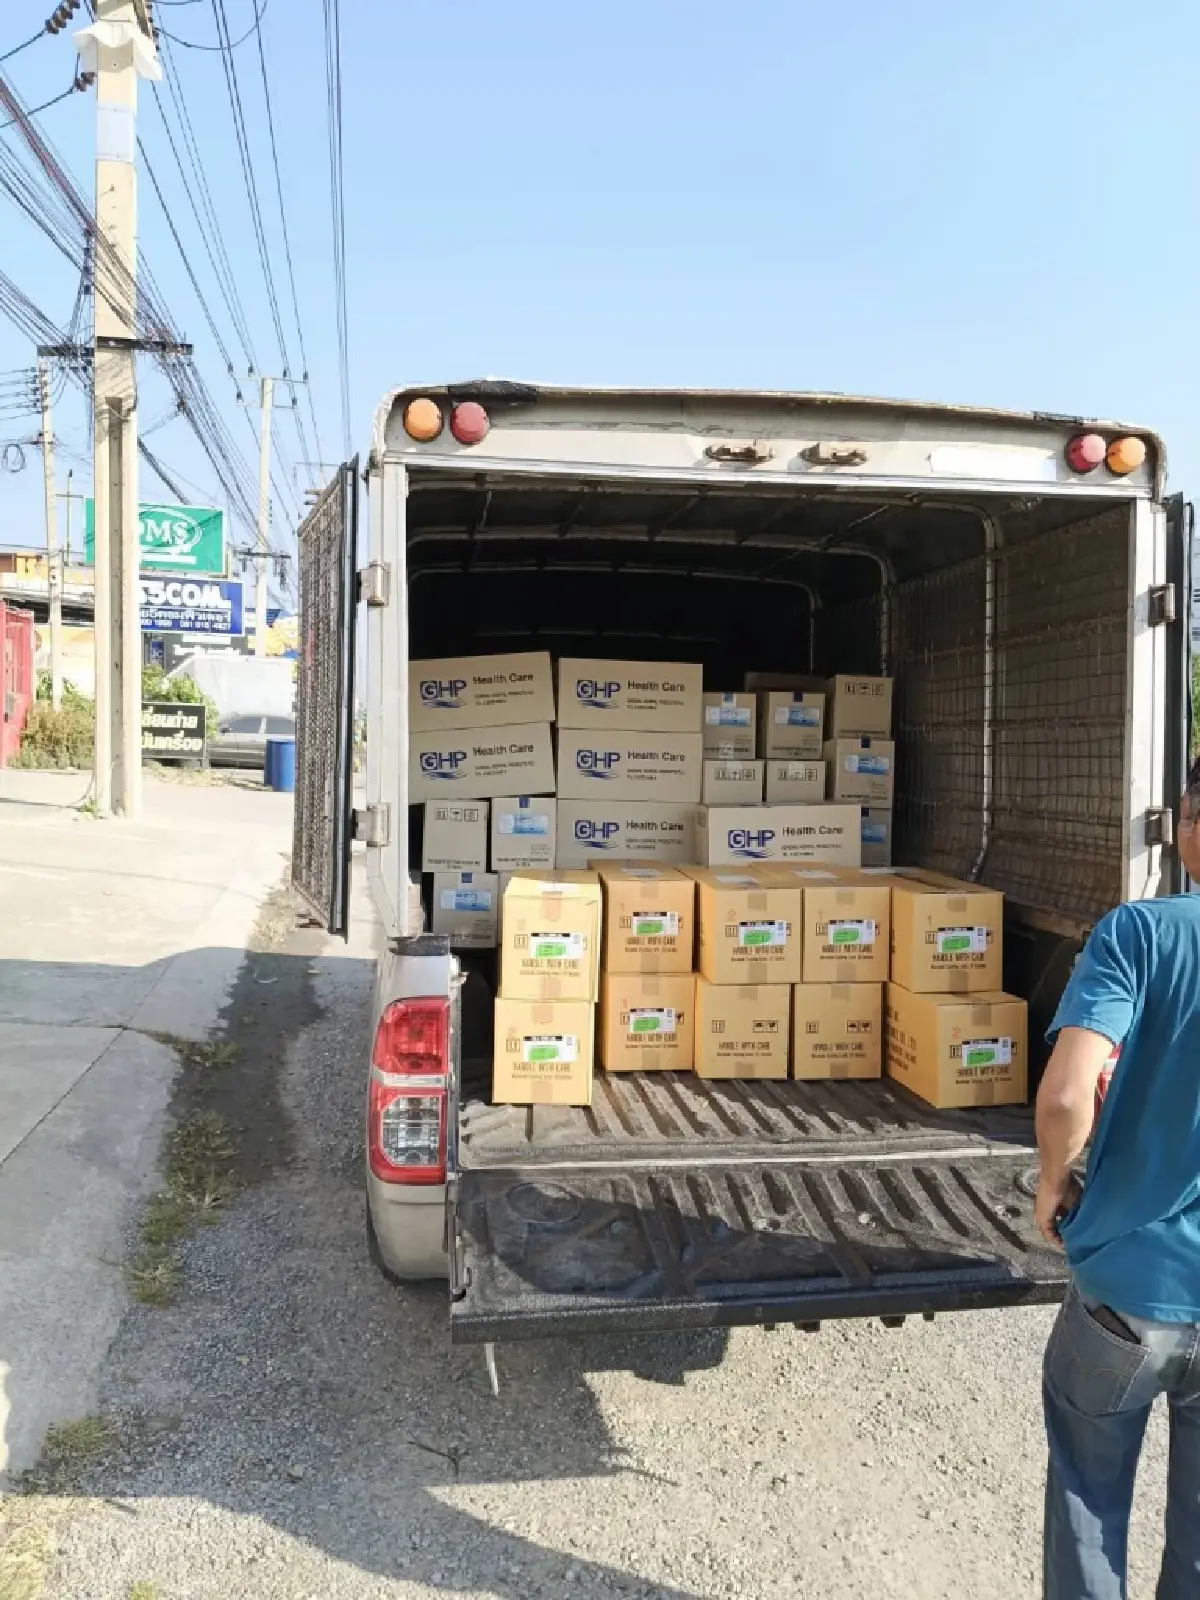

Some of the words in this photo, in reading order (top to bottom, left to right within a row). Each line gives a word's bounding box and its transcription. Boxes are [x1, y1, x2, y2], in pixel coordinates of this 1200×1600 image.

[472, 674, 507, 685] Health
[509, 672, 534, 682] Care
[627, 680, 659, 691] Health
[661, 682, 685, 692] Care
[420, 679, 467, 700] GHP
[577, 679, 621, 698] GHP
[472, 745, 507, 756] Health
[508, 743, 534, 753] Care
[627, 750, 659, 760] Health
[661, 752, 685, 761] Care
[420, 751, 467, 771] GHP
[577, 749, 621, 769] GHP
[575, 820, 620, 839] GHP
[626, 820, 658, 831] Health
[660, 821, 684, 831] Care
[782, 826, 816, 836] Health
[818, 825, 843, 835] Care
[728, 829, 775, 849] GHP
